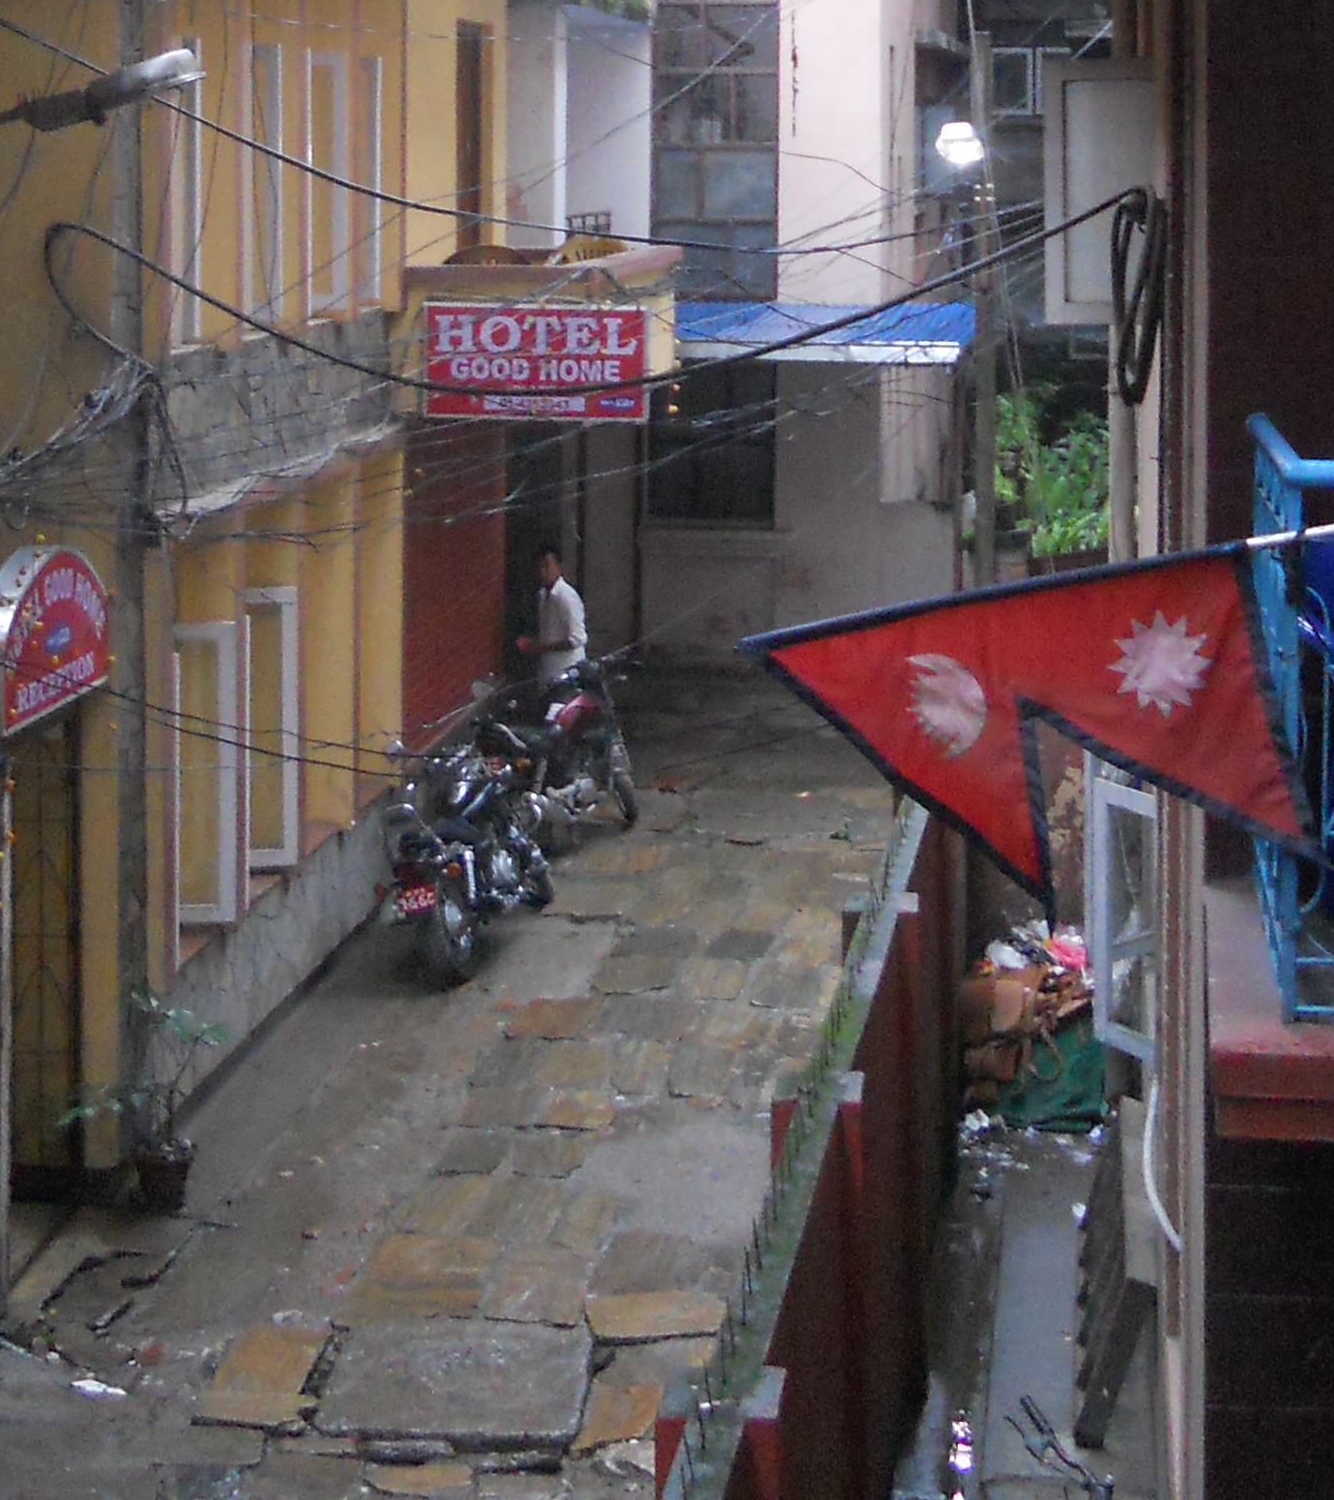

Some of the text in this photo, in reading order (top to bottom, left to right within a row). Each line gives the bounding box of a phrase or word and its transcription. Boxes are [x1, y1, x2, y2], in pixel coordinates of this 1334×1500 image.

[434, 314, 638, 356] HOTEL
[449, 357, 621, 383] GOOD HOME
